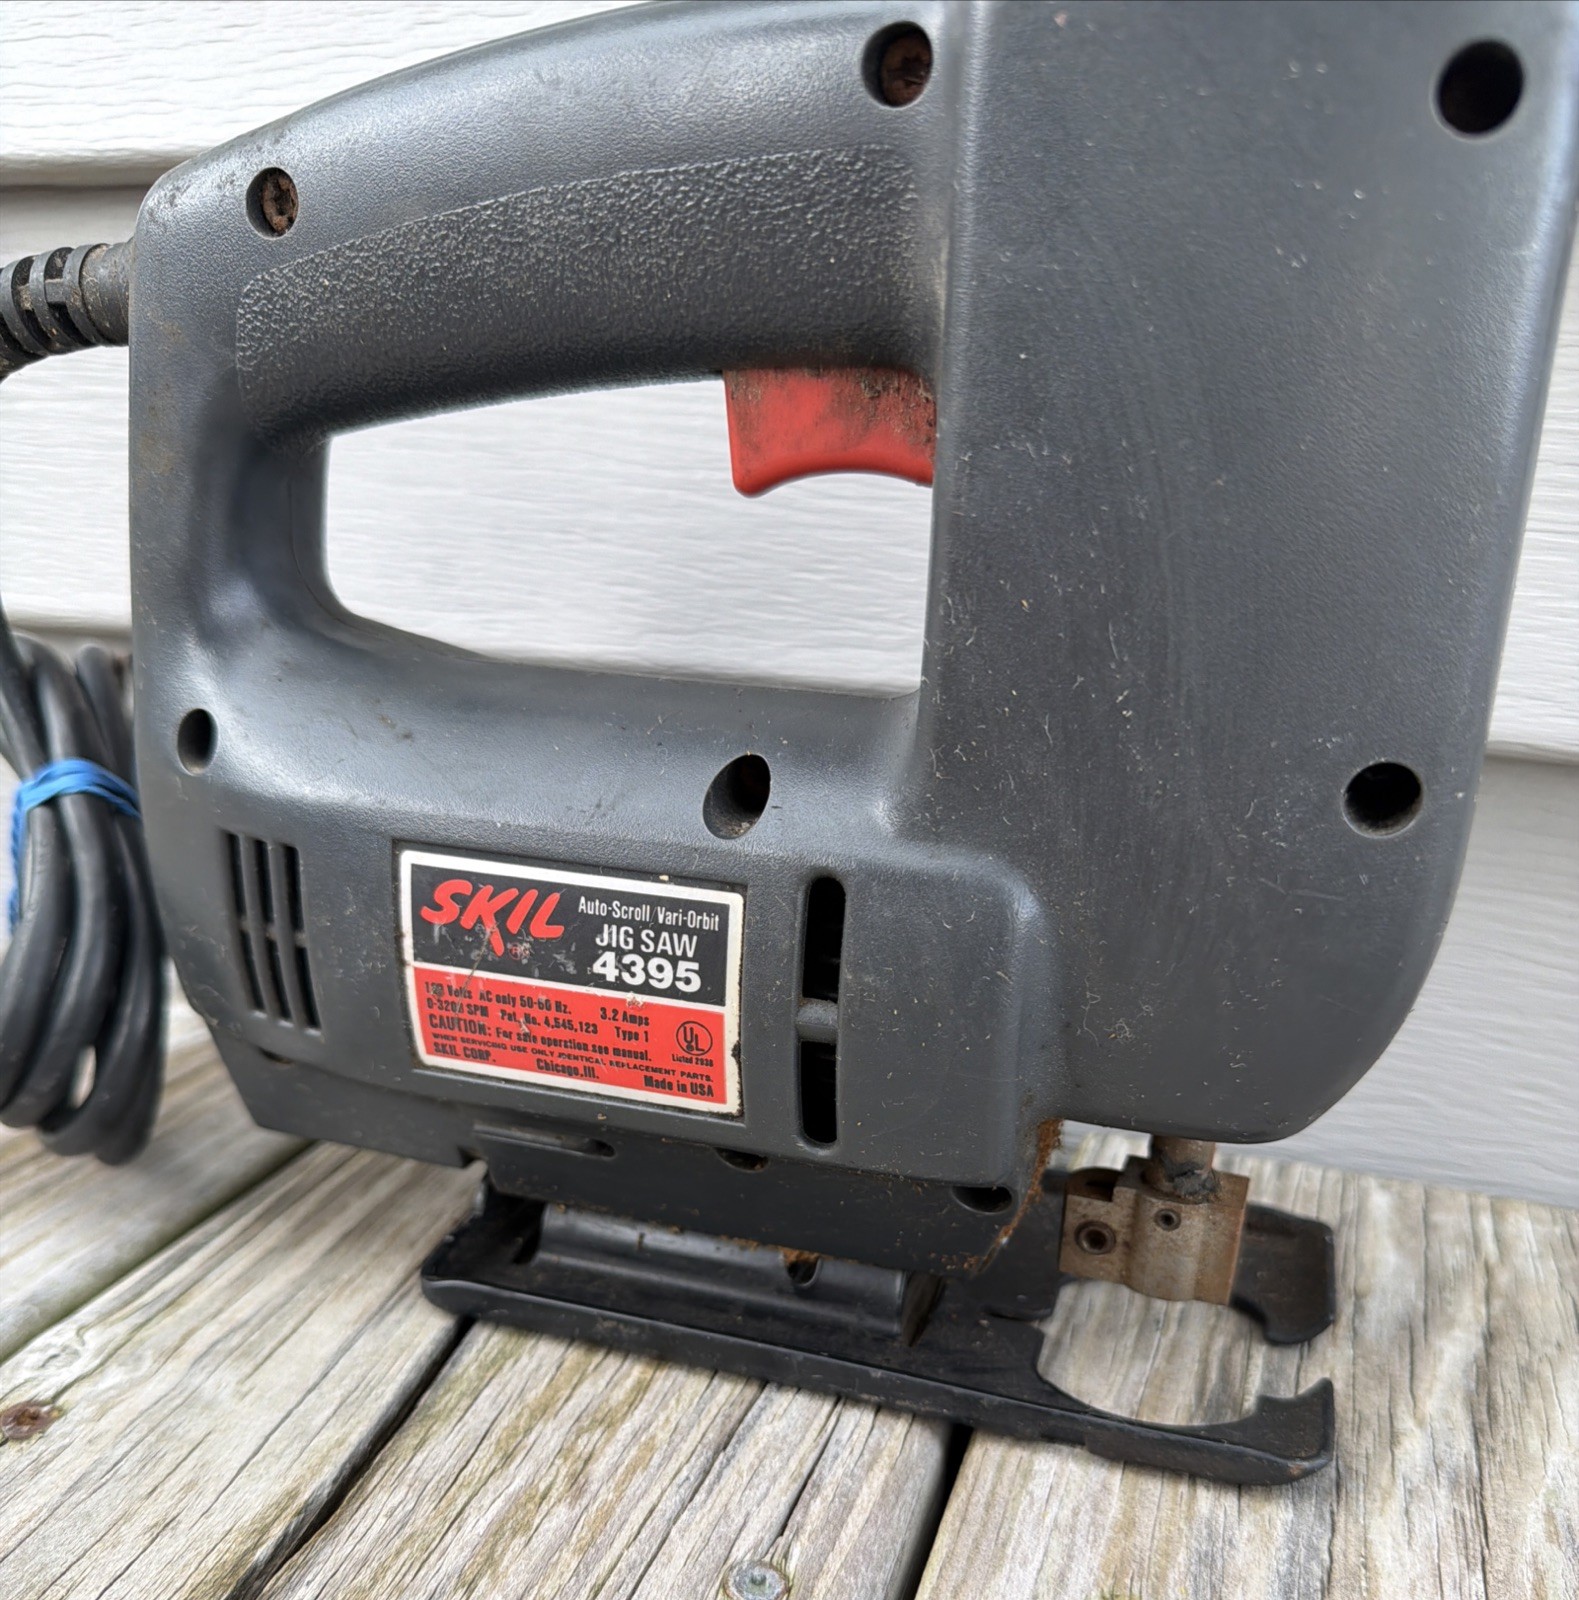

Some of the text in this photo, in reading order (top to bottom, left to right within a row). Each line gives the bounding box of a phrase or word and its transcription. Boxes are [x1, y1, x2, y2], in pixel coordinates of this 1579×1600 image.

[421, 879, 565, 957] SKIL
[595, 923, 698, 958] JIG SAW
[592, 951, 702, 993] 4395
[447, 985, 472, 1000] Volts
[479, 990, 493, 1003] AC
[496, 993, 516, 1008] only
[519, 995, 552, 1012] 50-60
[555, 1001, 572, 1015] Hz.
[467, 1004, 489, 1018] SPM
[523, 1012, 541, 1026] No.
[600, 1007, 650, 1027] 3.2 Amps
[428, 1013, 652, 1062] CAUTION: For safe operation see manual.
[614, 1026, 650, 1043] Type 1
[432, 1032, 713, 1083] WHEN SERVICING USE ONLY IDENTICAL REPLACEMENT PARTS.
[433, 1042, 497, 1063] SKIL CORP.
[671, 1053, 693, 1065] Listed
[643, 1074, 715, 1098] Made in USA
